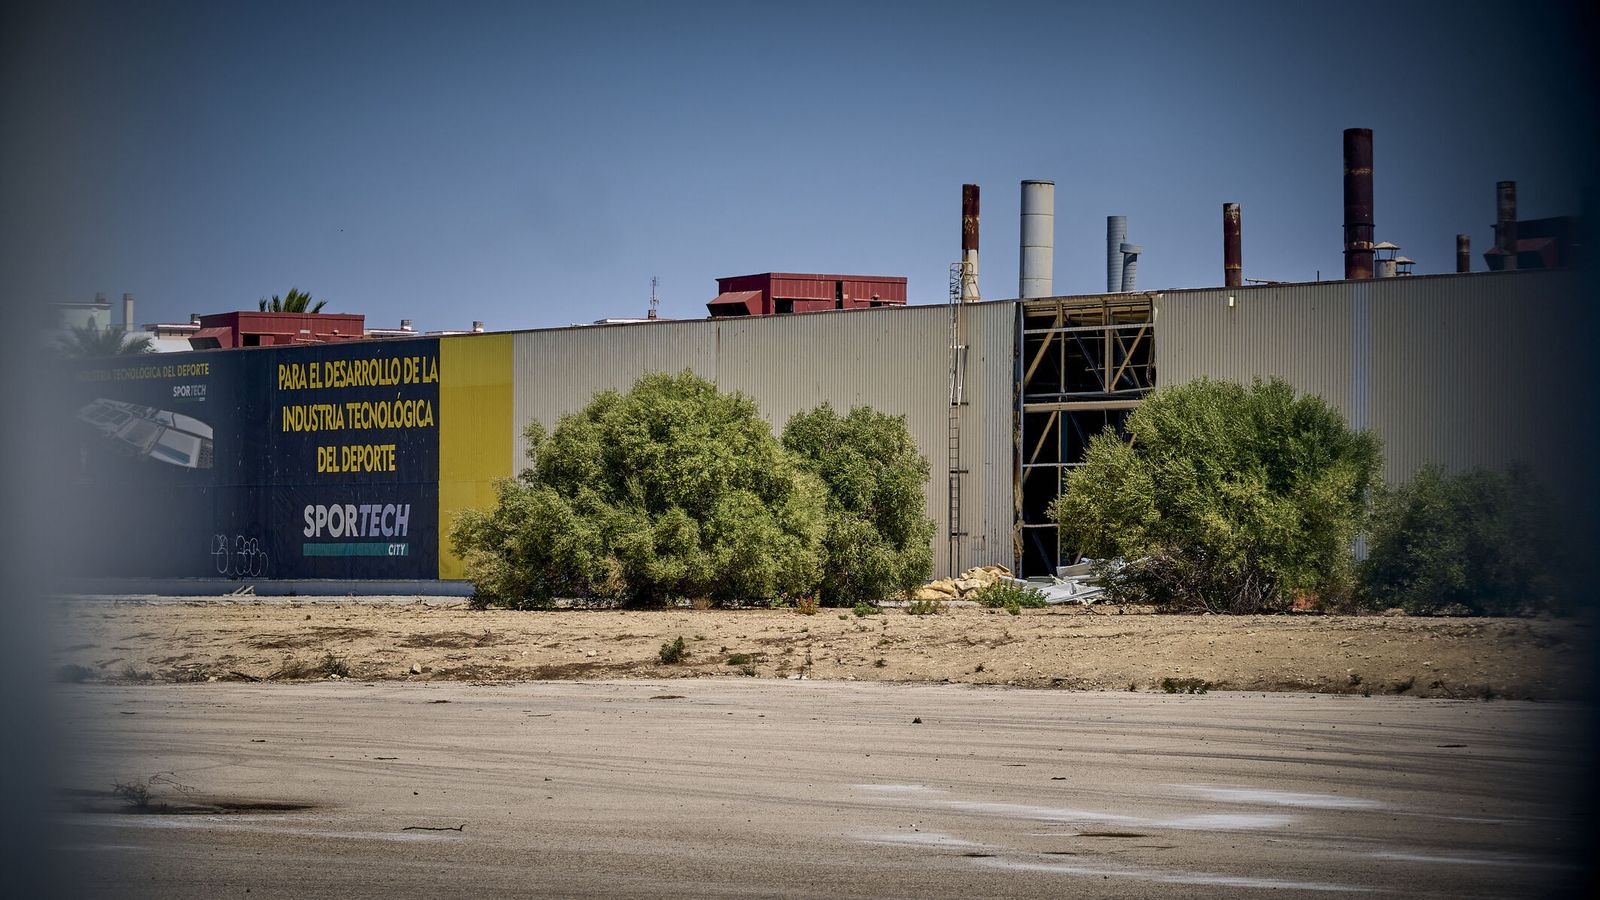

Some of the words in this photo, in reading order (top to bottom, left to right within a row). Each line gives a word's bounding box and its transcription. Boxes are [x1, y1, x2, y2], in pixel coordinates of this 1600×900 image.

[163, 366, 176, 377] DEL
[177, 363, 209, 376] DEPORTE
[278, 363, 307, 390] PARA
[310, 362, 323, 389] EL
[324, 357, 401, 388] DESARROLLO
[403, 356, 420, 384] DE
[422, 355, 438, 383] LA
[173, 385, 206, 397] SPORTECH
[282, 403, 345, 432] INDUSTRIA
[346, 392, 434, 430] TECNOLÓGICA
[317, 446, 339, 473] DEL
[341, 444, 396, 472] DEPORTE
[303, 503, 411, 538] SPORTECH
[388, 543, 406, 556] CITY
